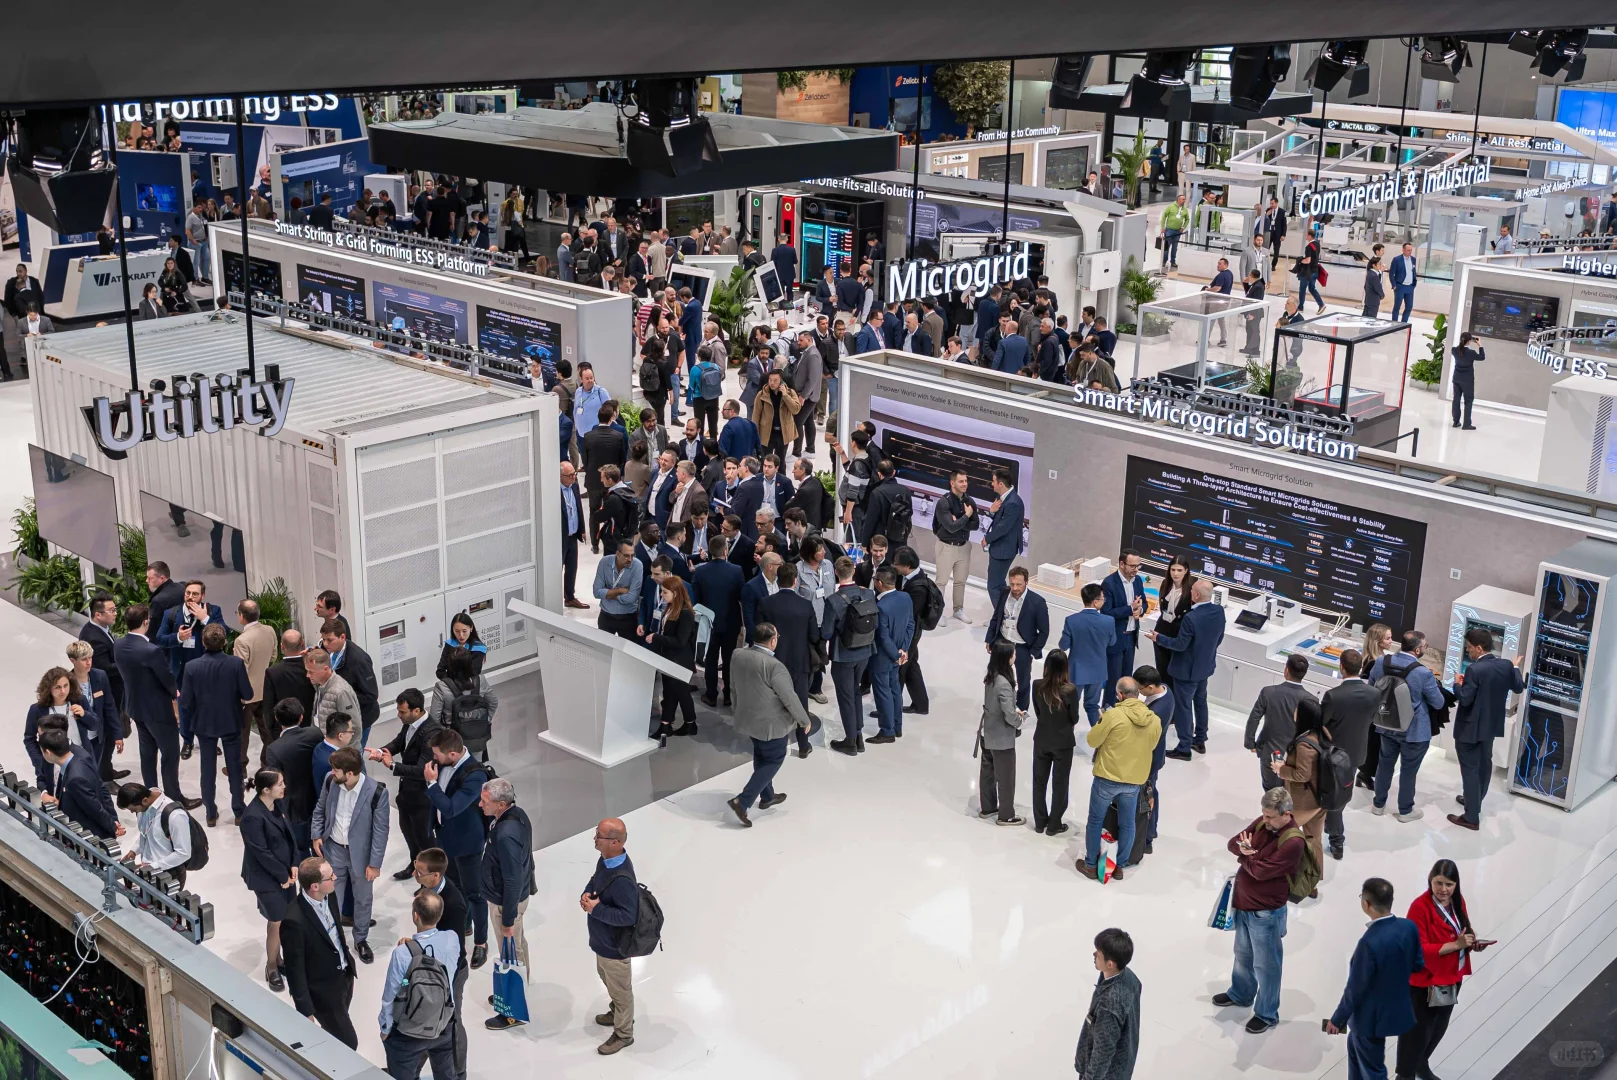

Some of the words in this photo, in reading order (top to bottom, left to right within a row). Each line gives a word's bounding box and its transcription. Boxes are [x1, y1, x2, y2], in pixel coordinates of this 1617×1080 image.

[155, 97, 280, 121] Formng
[978, 131, 995, 141] From
[1016, 128, 1024, 137] to
[1025, 125, 1061, 136] Community
[1490, 136, 1505, 147] All
[1299, 172, 1401, 219] Commercial
[1405, 170, 1418, 197] &
[1422, 156, 1492, 195] Industrial
[1523, 186, 1540, 199] Home
[1552, 180, 1572, 193] Always
[274, 219, 302, 238] Smart
[305, 225, 333, 247] String
[335, 231, 344, 247] &
[346, 233, 368, 251] Grid
[370, 238, 413, 263] Forming
[415, 247, 434, 265] ESS
[437, 252, 485, 276] Platform
[889, 241, 1029, 303] Microgrid
[1581, 289, 1598, 297] Hybrid
[1526, 339, 1564, 374] Cooling
[1571, 357, 1608, 380] ESS
[97, 373, 296, 451] Utility
[876, 383, 900, 394] Empower
[901, 388, 917, 398] World
[917, 391, 929, 401] with
[929, 394, 947, 405] Stable
[953, 399, 979, 411] Economic
[979, 405, 1010, 419] Renewable
[1010, 413, 1030, 424] Energy
[1072, 383, 1135, 414] Smart
[1142, 397, 1249, 438] Microgrid
[1254, 422, 1357, 460] Solution
[1202, 474, 1230, 487] One-stop
[1230, 481, 1258, 493] Standard
[1258, 486, 1277, 498] Smart
[1277, 490, 1311, 506] Microgrids
[1311, 499, 1338, 511] Solution
[1229, 462, 1249, 473] Smart
[1251, 467, 1284, 482] Microgrid
[1284, 475, 1313, 489] Solution
[1161, 471, 1186, 483] Building
[1192, 478, 1225, 492] Three-layer
[1225, 486, 1262, 500] Architecture
[1262, 494, 1270, 502] to
[1270, 496, 1293, 508] Ensure
[1293, 501, 1352, 521] Cost-effectiveness
[1358, 517, 1386, 530] Stability
